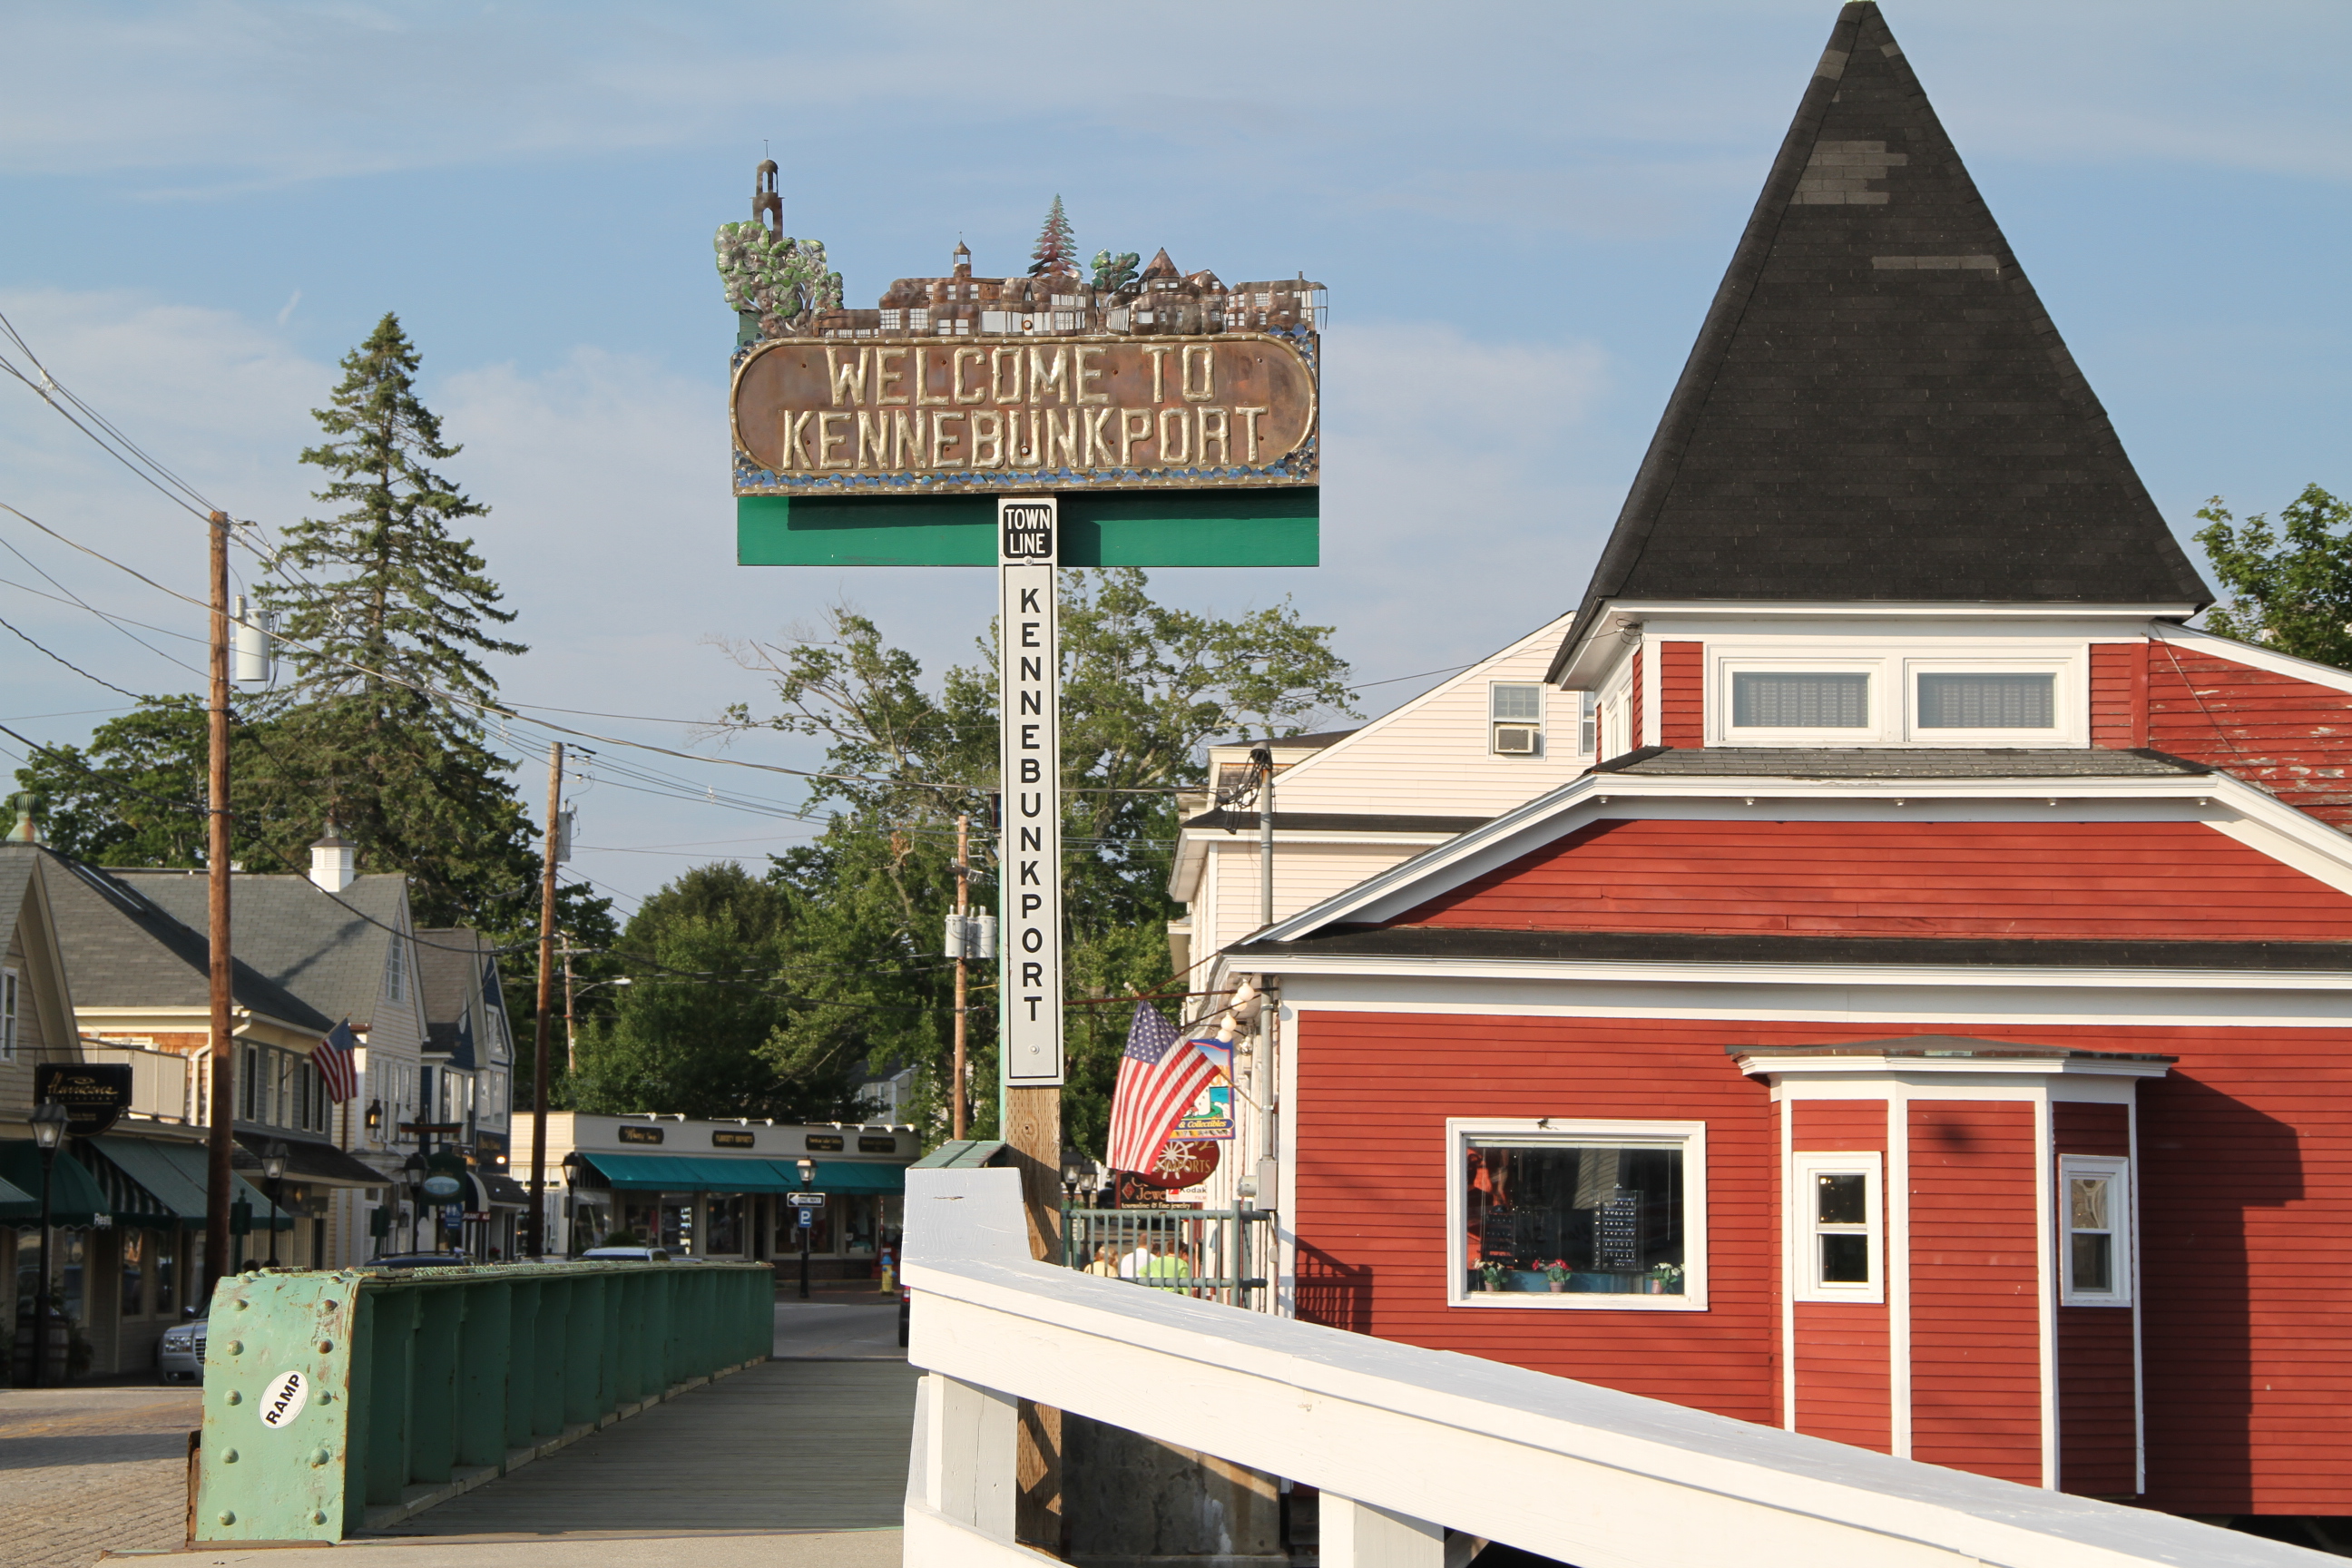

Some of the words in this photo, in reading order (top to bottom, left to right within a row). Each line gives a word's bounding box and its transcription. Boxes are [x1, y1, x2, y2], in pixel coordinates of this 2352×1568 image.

[825, 346, 1109, 407] WELCOME
[1142, 344, 1215, 403] TO
[782, 406, 1269, 469] KENNEBUNKPORT
[1005, 508, 1050, 529] TOWN
[1010, 533, 1045, 554] LINE
[1021, 588, 1043, 1021] KENNEBUNKPORT
[1187, 1120, 1227, 1128] Collectibles
[1136, 1187, 1167, 1200] Jewe
[800, 1210, 810, 1223] P
[265, 1374, 299, 1425] RAMP
